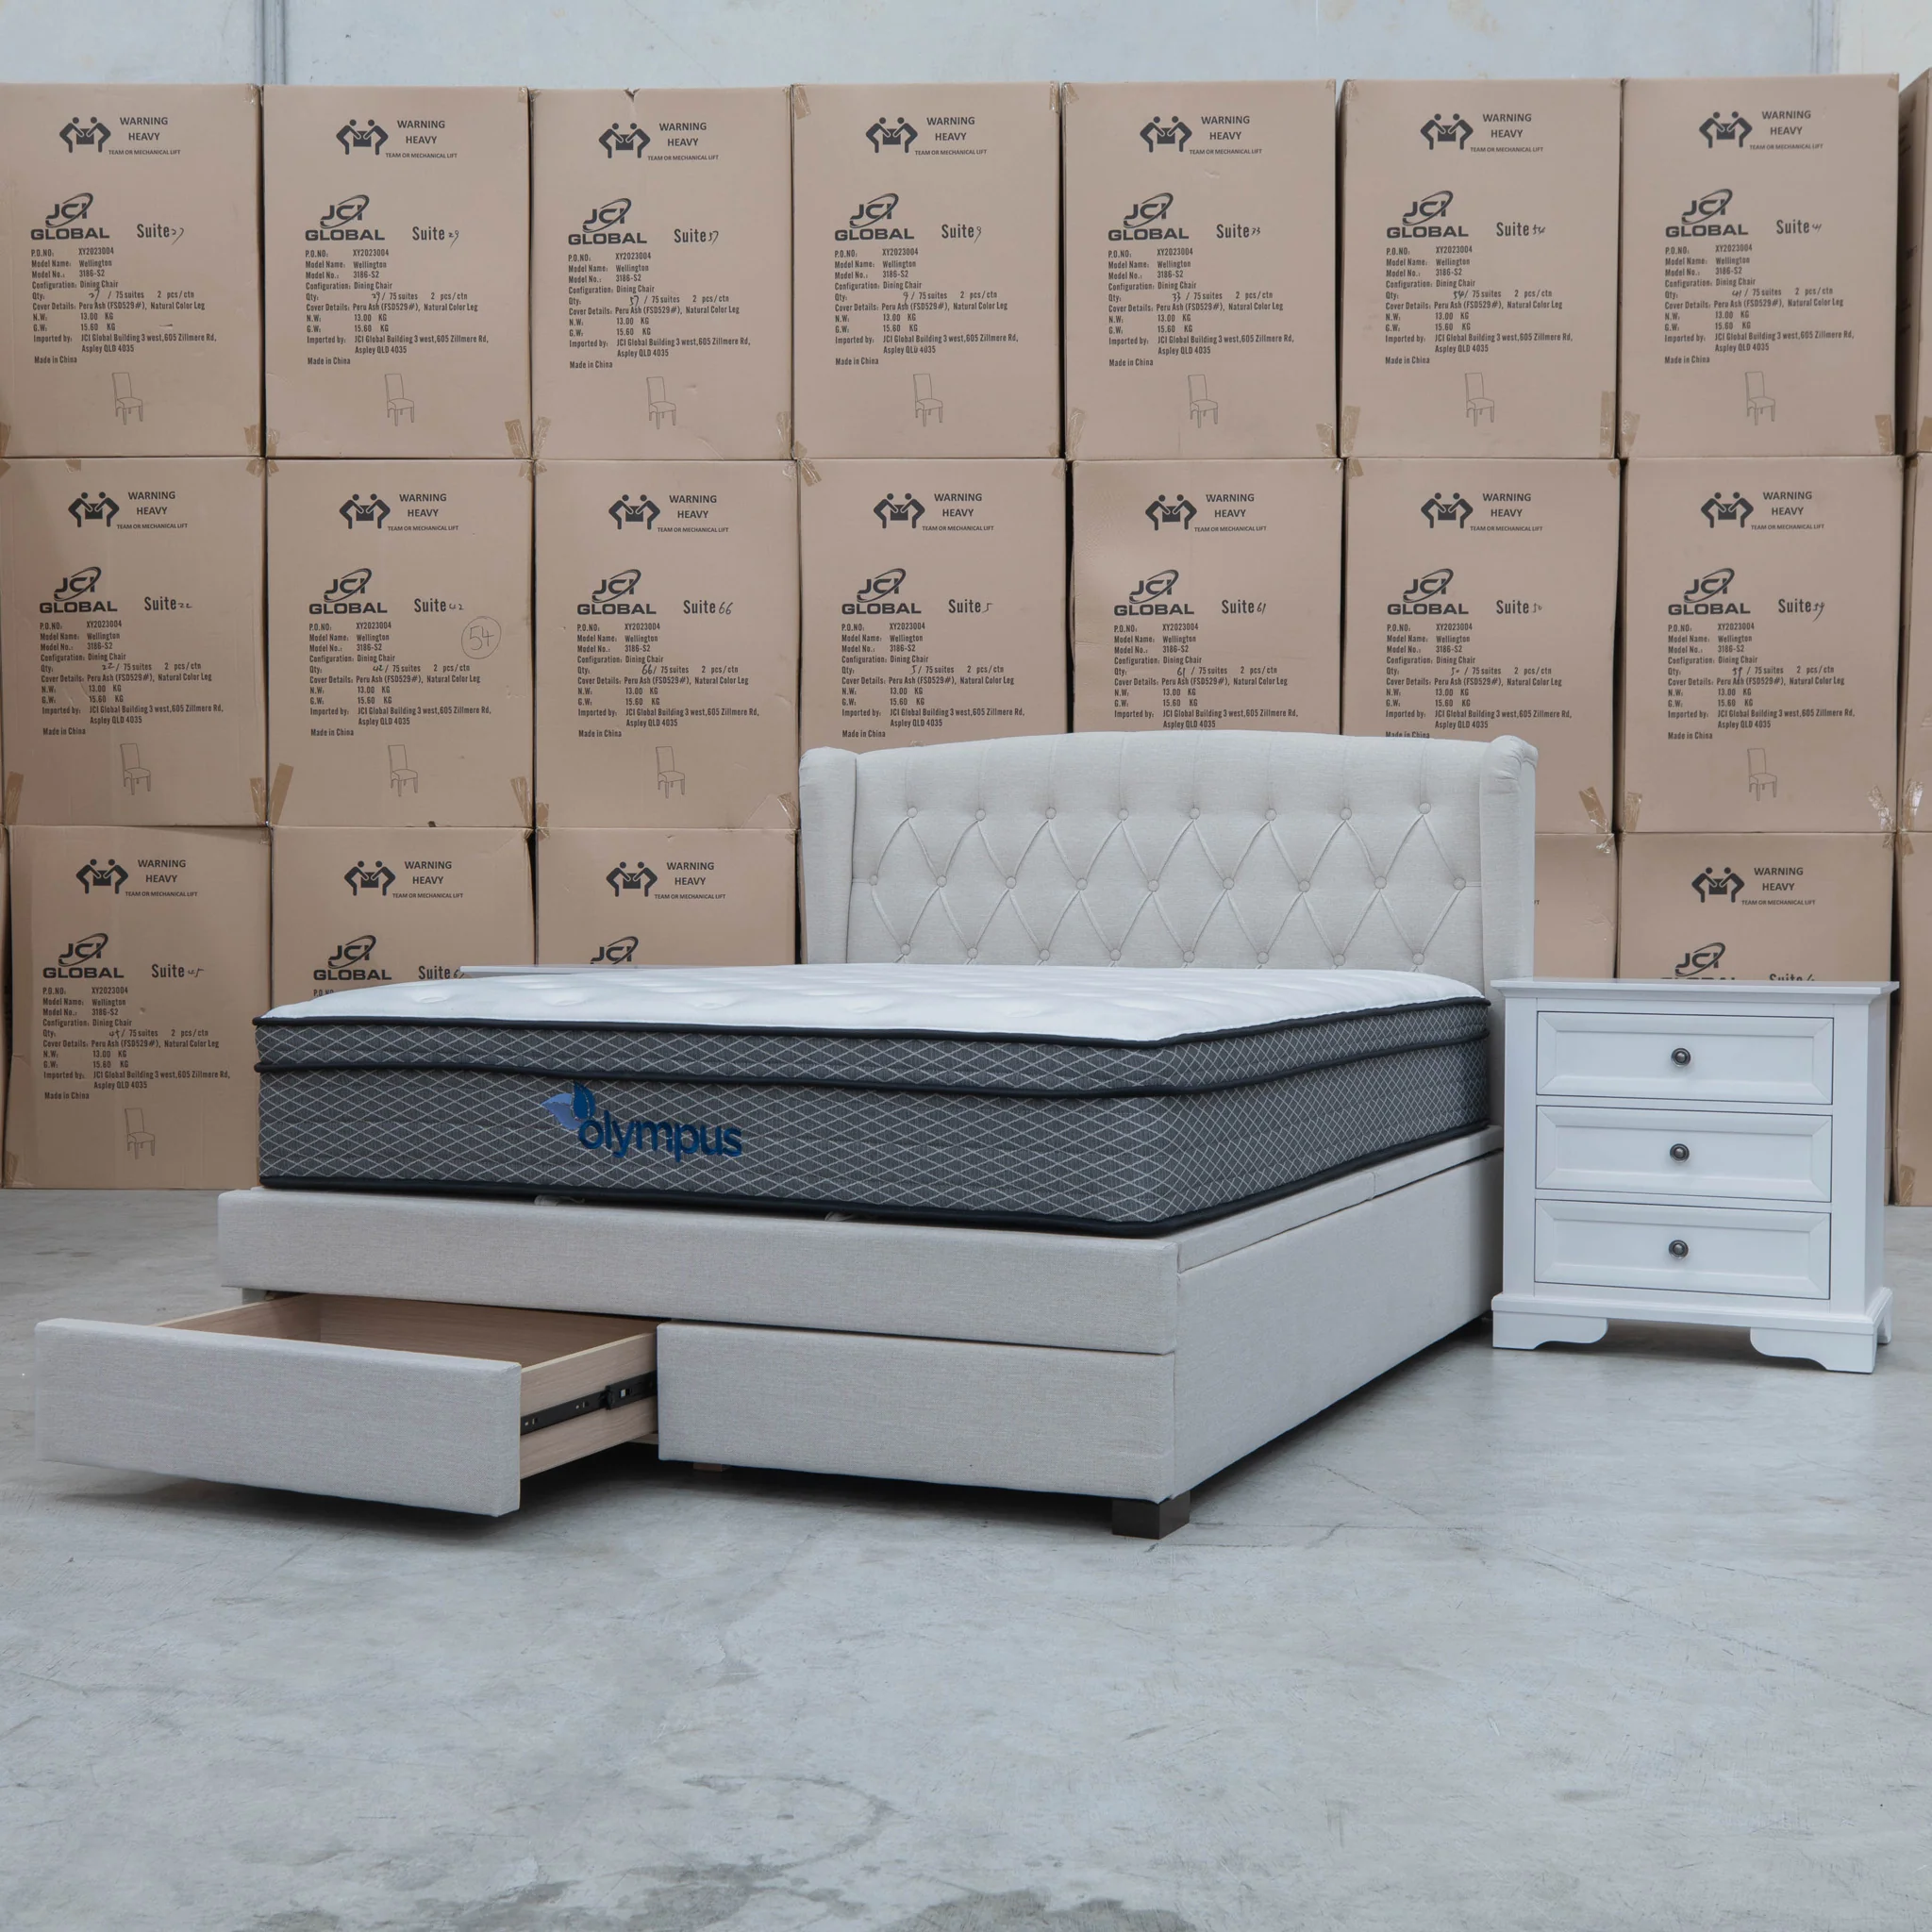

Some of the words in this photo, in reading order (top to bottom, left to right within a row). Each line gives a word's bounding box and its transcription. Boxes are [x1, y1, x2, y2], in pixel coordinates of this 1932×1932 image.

[1202, 115, 1250, 125] WARNING
[1483, 113, 1532, 123] WARNING
[1762, 110, 1812, 120] WARNING
[120, 116, 168, 125] WARNING
[397, 119, 445, 128] WARNING
[926, 116, 974, 125] WARNING
[659, 122, 707, 131] WARNING
[1771, 126, 1803, 135] HEAVY
[128, 132, 159, 141] HEAVY
[935, 132, 967, 141] HEAVY
[1209, 131, 1241, 140] HEAVY
[1491, 129, 1524, 138] HEAVY
[406, 135, 437, 144] HEAVY
[667, 138, 698, 146] HEAVY
[137, 224, 170, 238] Suite
[1217, 225, 1250, 239] Suite
[1387, 225, 1469, 239] GLOBAL
[1496, 222, 1530, 237] Suite
[1666, 225, 1748, 238] GLOBAL
[1776, 220, 1810, 234] Suite
[30, 227, 110, 241] GLOBAL
[306, 228, 385, 242] GLOBAL
[412, 226, 445, 241] Suite
[448, 230, 459, 248] 29
[568, 233, 647, 245] GLOBAL
[674, 229, 707, 243] Suite
[835, 228, 914, 241] GLOBAL
[941, 225, 974, 239] Suite
[974, 226, 982, 244] 9
[1108, 228, 1189, 241] GLOBAL
[353, 249, 389, 258] XY2023004
[1435, 268, 1462, 276] 3186-S2
[835, 281, 880, 291] Configuration:
[883, 281, 903, 291] Dining
[1109, 337, 1137, 345] Imported
[1139, 337, 1149, 345] by:
[1191, 335, 1217, 344] Building
[1158, 347, 1178, 356] Aspley
[127, 491, 175, 500] WARNING
[399, 493, 446, 502] WARNING
[669, 494, 717, 504] WARNING
[934, 492, 982, 502] WARNING
[1207, 493, 1255, 503] WARNING
[1483, 492, 1532, 502] WARNING
[1763, 491, 1812, 500] WARNING
[136, 507, 167, 515] HEAVY
[408, 508, 439, 517] HEAVY
[677, 510, 708, 519] HEAVY
[942, 508, 974, 517] HEAVY
[1215, 509, 1246, 518] HEAVY
[1491, 508, 1523, 517] HEAVY
[1772, 508, 1804, 516] HEAVY
[40, 601, 118, 613] GLOBAL
[144, 597, 177, 611] Suite
[309, 602, 388, 615] GLOBAL
[414, 599, 447, 613] Suite
[683, 600, 716, 614] Suite
[718, 601, 734, 615] 66
[842, 603, 922, 615] GLOBAL
[948, 599, 981, 613] Suite
[982, 602, 993, 614] 5
[1222, 600, 1255, 614] Suite
[1257, 602, 1267, 615] 61
[1496, 600, 1529, 615] Suite
[1669, 603, 1750, 615] GLOBAL
[1778, 599, 1811, 613] Suite
[577, 603, 657, 616] GLOBAL
[1114, 604, 1194, 616] GLOBAL
[1388, 603, 1469, 616] GLOBAL
[468, 625, 495, 651] 54
[1407, 677, 1431, 686] Details:
[1507, 677, 1531, 686] Natural
[1533, 677, 1550, 686] Color
[1551, 678, 1562, 687] Leg
[138, 858, 187, 868] WARNING
[405, 860, 452, 870] WARNING
[666, 861, 714, 871] WARNING
[1754, 867, 1803, 875] WARNING
[145, 874, 178, 883] HEAVY
[412, 876, 443, 885] HEAVY
[675, 877, 706, 886] HEAVY
[1762, 883, 1794, 891] HEAVY
[43, 966, 125, 979] GLOBAL
[152, 964, 186, 978] Suite
[313, 969, 391, 982] GLOBAL
[418, 966, 451, 980] Suite
[63, 997, 85, 1006] Name:
[92, 997, 126, 1007] Wellington
[578, 1109, 742, 1162] olympus
